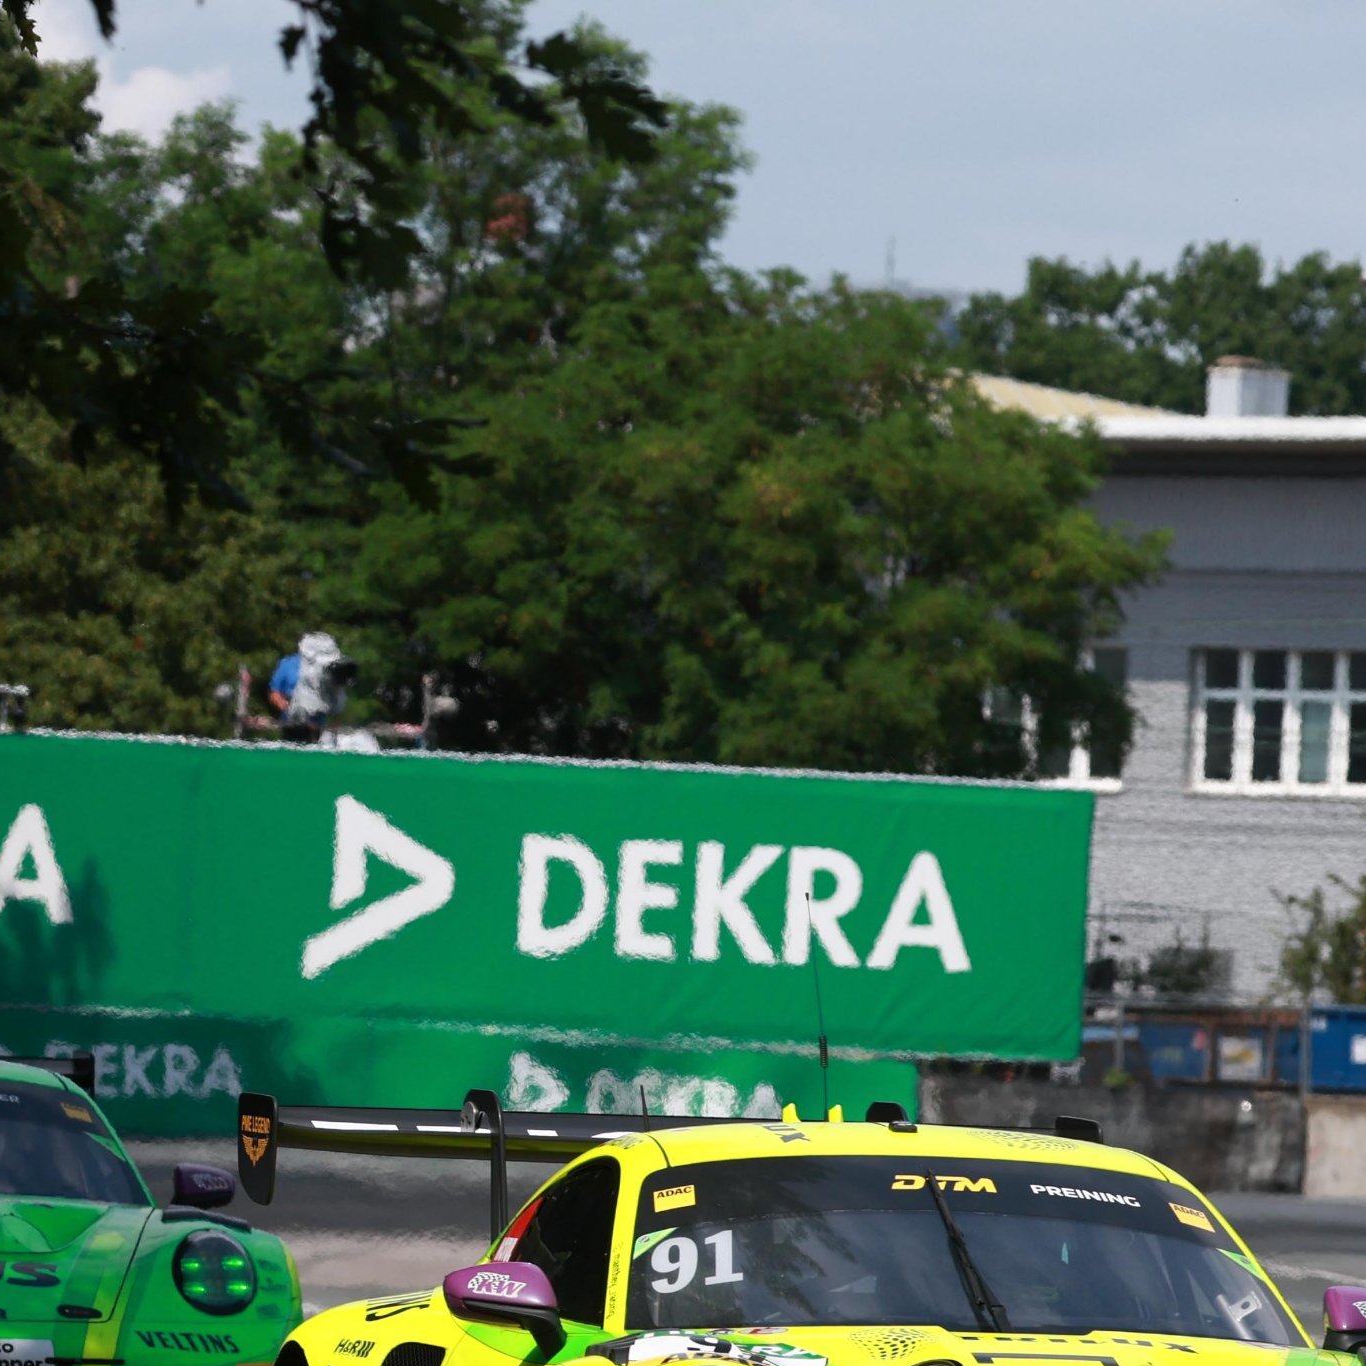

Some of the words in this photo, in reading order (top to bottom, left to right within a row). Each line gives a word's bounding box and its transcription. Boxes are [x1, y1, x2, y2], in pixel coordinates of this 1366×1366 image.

[516, 832, 972, 974] DEKRA
[657, 1186, 693, 1198] ADAC
[891, 1174, 998, 1193] DTM
[1030, 1184, 1141, 1207] PREINING
[651, 1230, 744, 1294] 91
[136, 1330, 241, 1354] VELTINS
